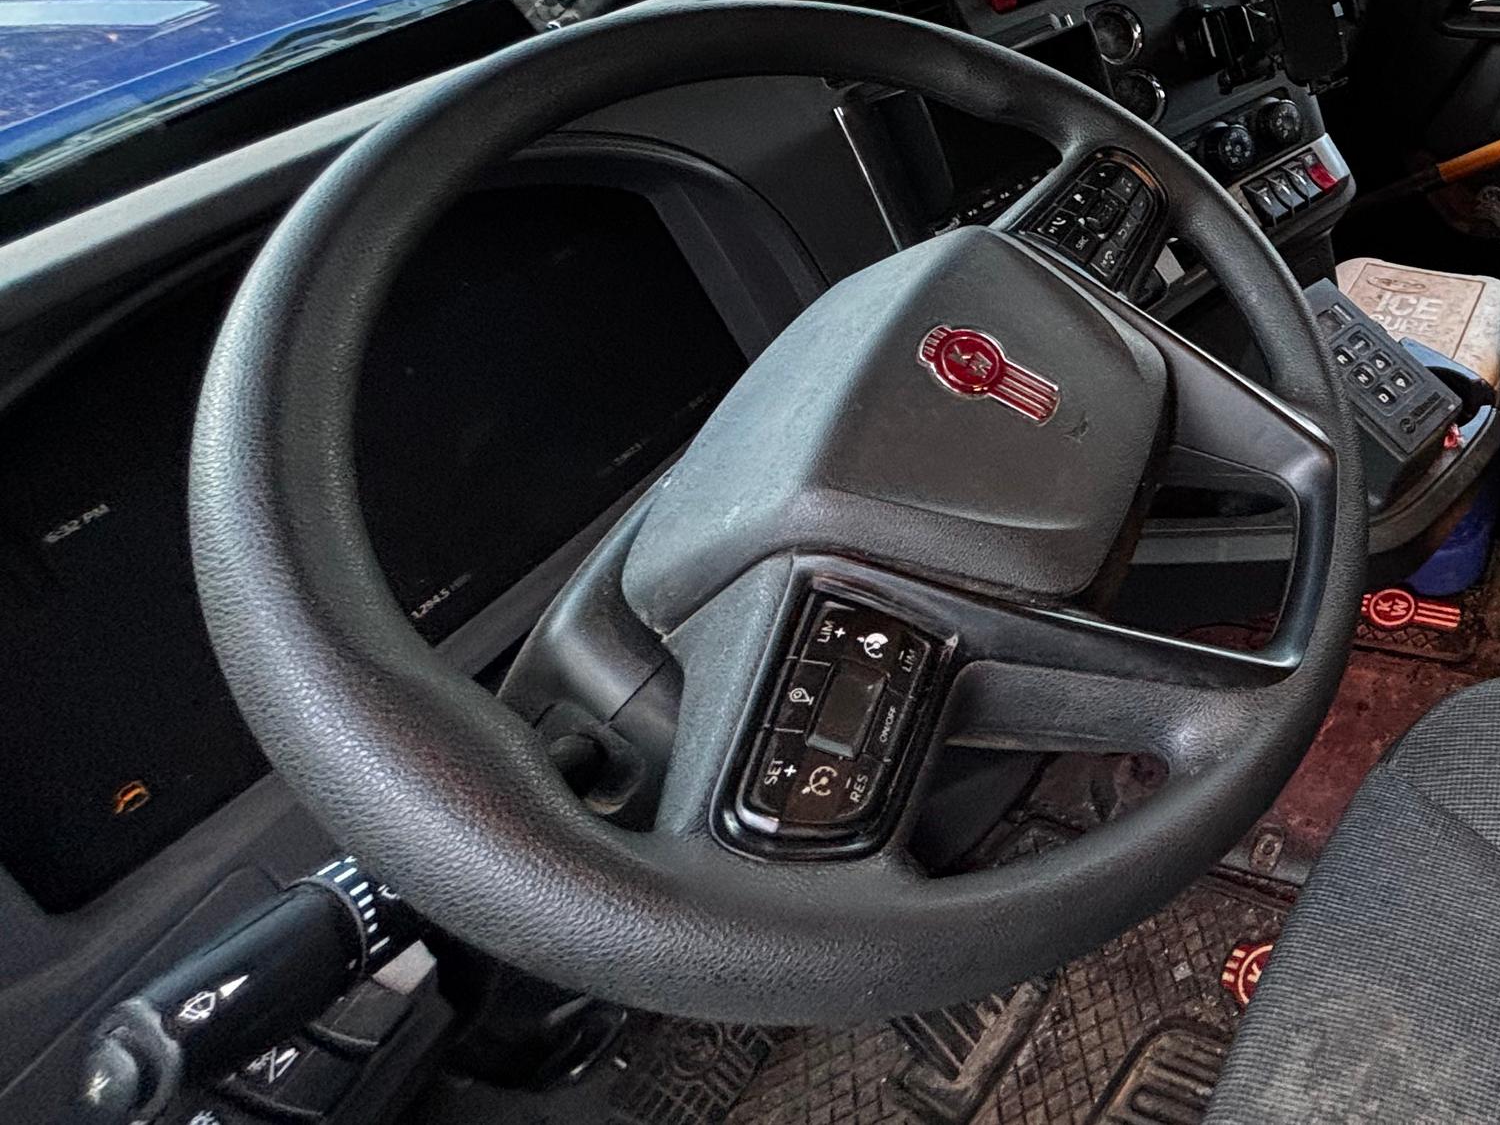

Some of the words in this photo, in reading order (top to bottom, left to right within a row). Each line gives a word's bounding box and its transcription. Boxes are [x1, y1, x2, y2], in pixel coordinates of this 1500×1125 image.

[1375, 290, 1443, 321] ICE
[1357, 373, 1369, 384] N
[1378, 393, 1389, 403] D
[817, 620, 835, 643] LIM
[902, 649, 917, 673] LIM
[879, 705, 897, 744] ON/OFF
[763, 759, 784, 785] SET
[849, 773, 869, 803] RES
